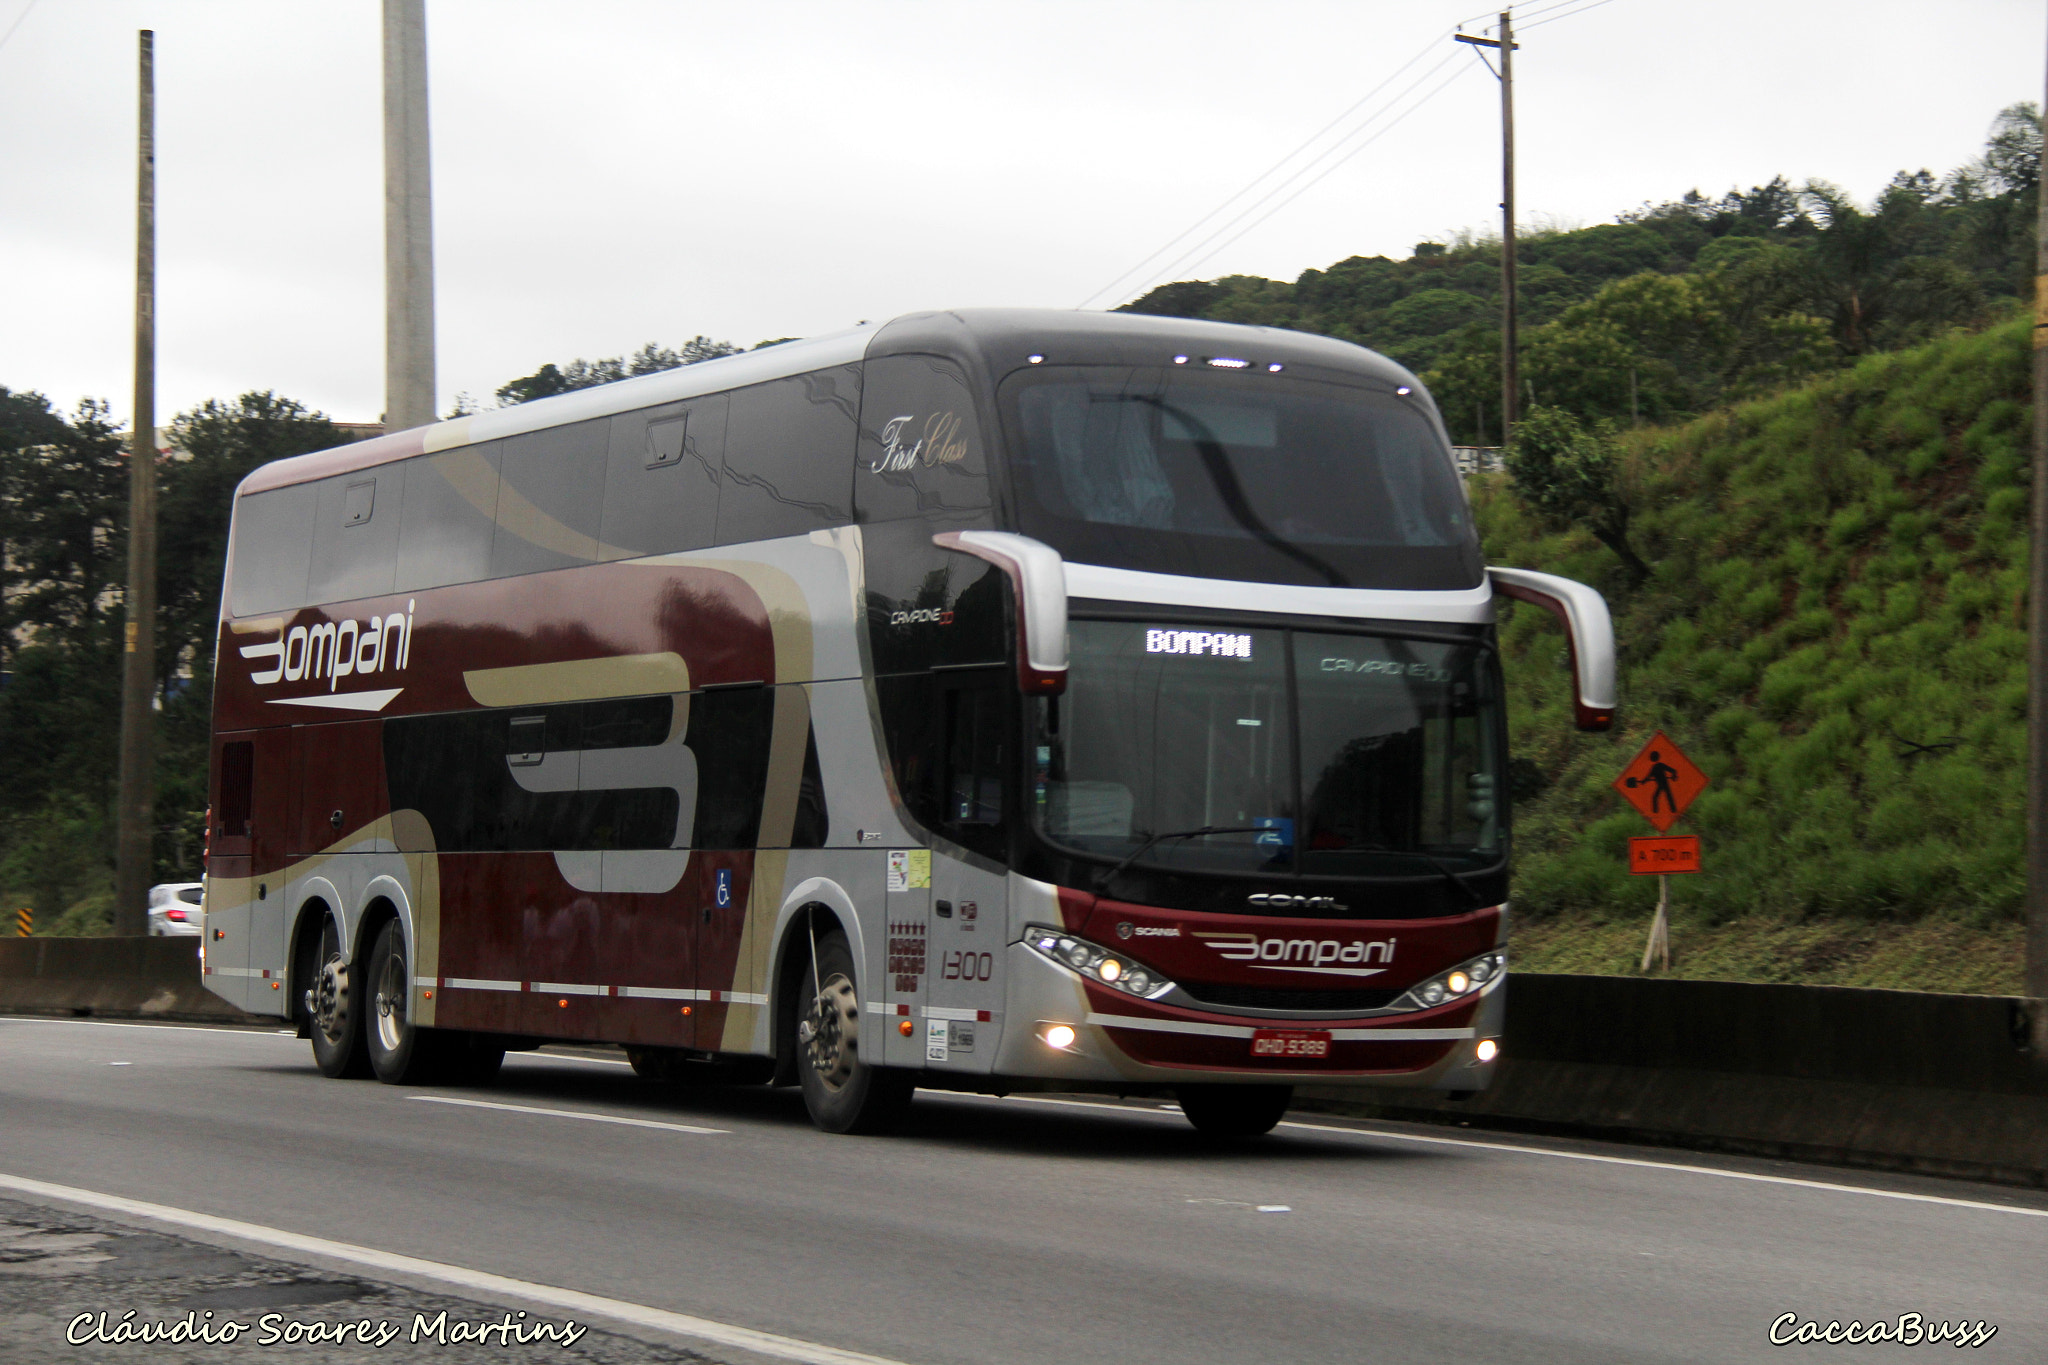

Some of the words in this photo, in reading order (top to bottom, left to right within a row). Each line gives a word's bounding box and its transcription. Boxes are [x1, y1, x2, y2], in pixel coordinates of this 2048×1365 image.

[871, 416, 922, 473] First
[924, 411, 968, 467] Class
[230, 598, 415, 692] Bompani
[1146, 628, 1252, 658] BOMPANI
[1135, 927, 1180, 936] SCANIA
[1190, 931, 1396, 966] Bompani
[941, 950, 993, 981] 1300
